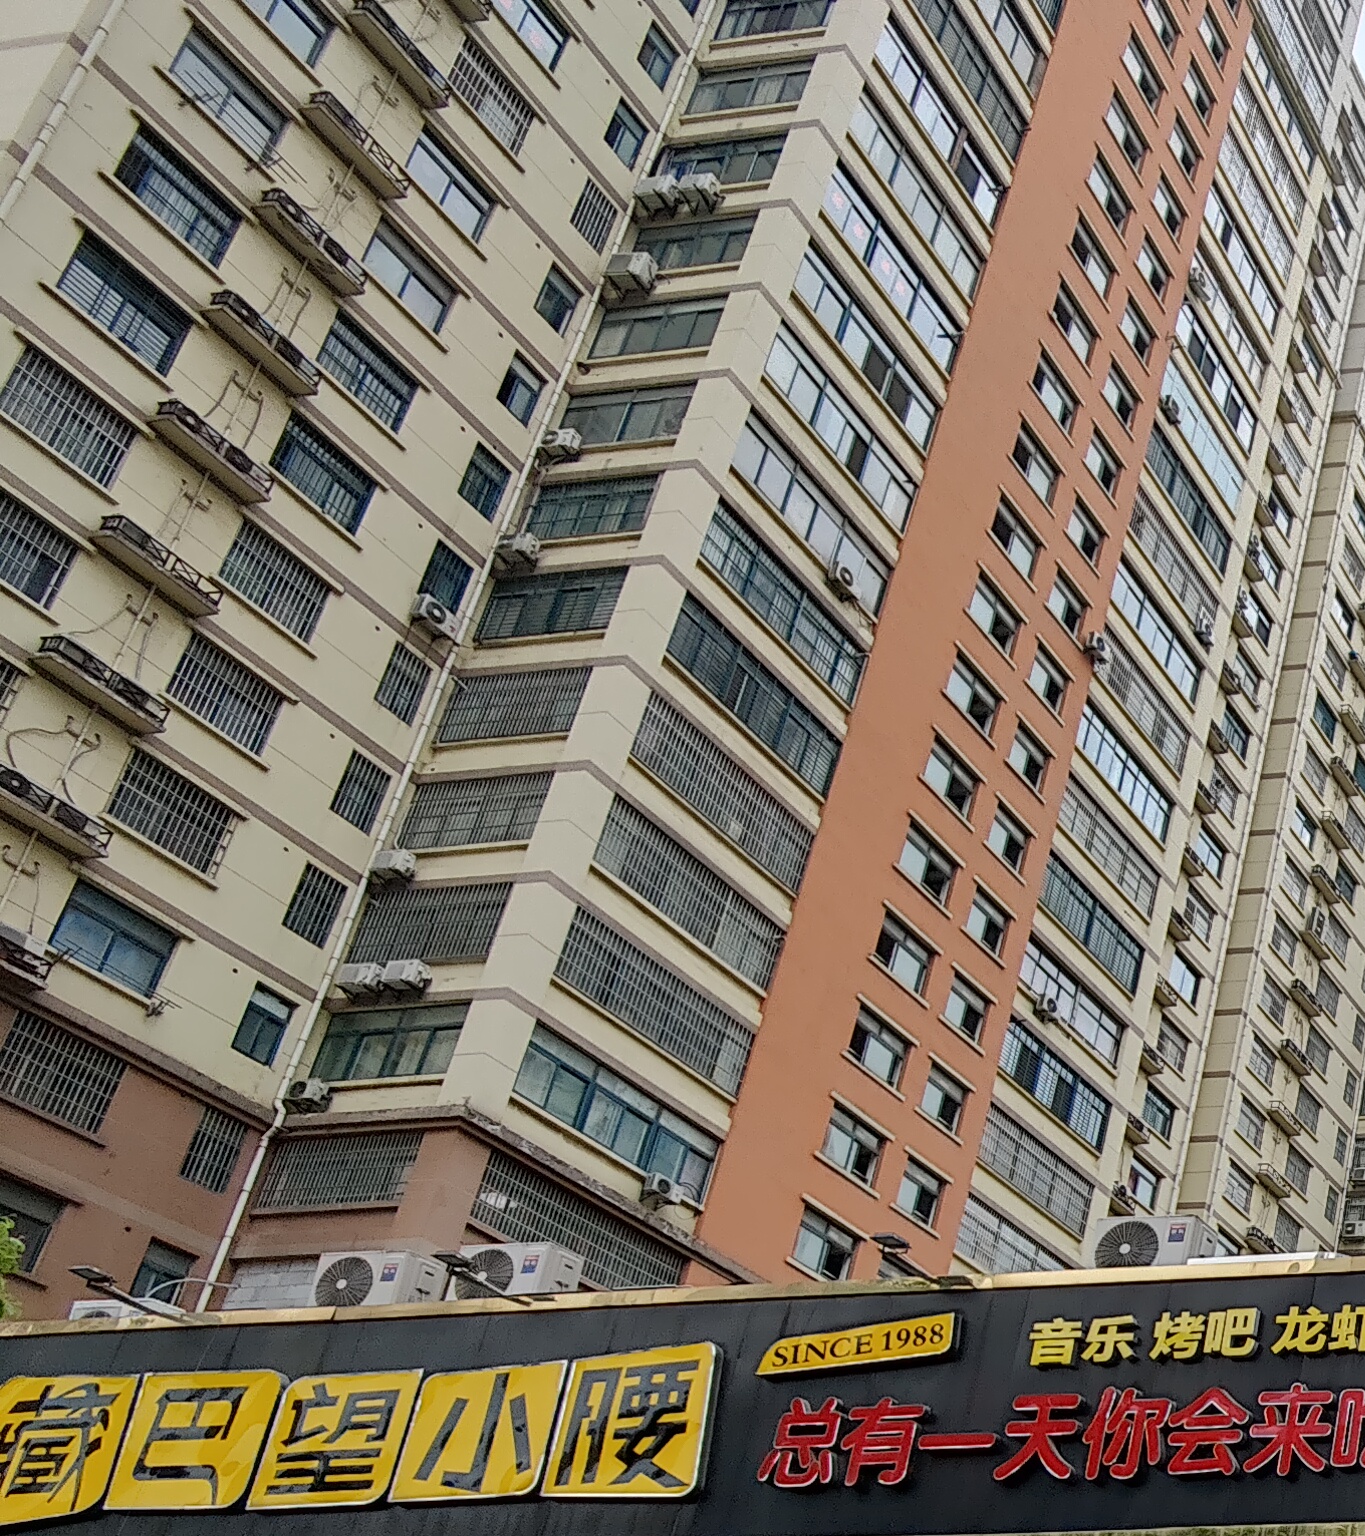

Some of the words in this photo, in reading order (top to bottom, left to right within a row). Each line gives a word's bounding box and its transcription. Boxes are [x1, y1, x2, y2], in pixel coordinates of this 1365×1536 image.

[769, 1332, 873, 1372] SINCE
[879, 1319, 948, 1357] 1988
[1028, 1312, 1138, 1368] 音乐
[1149, 1307, 1258, 1361] 烤吧
[0, 1360, 700, 1514] 藏巴望小腰
